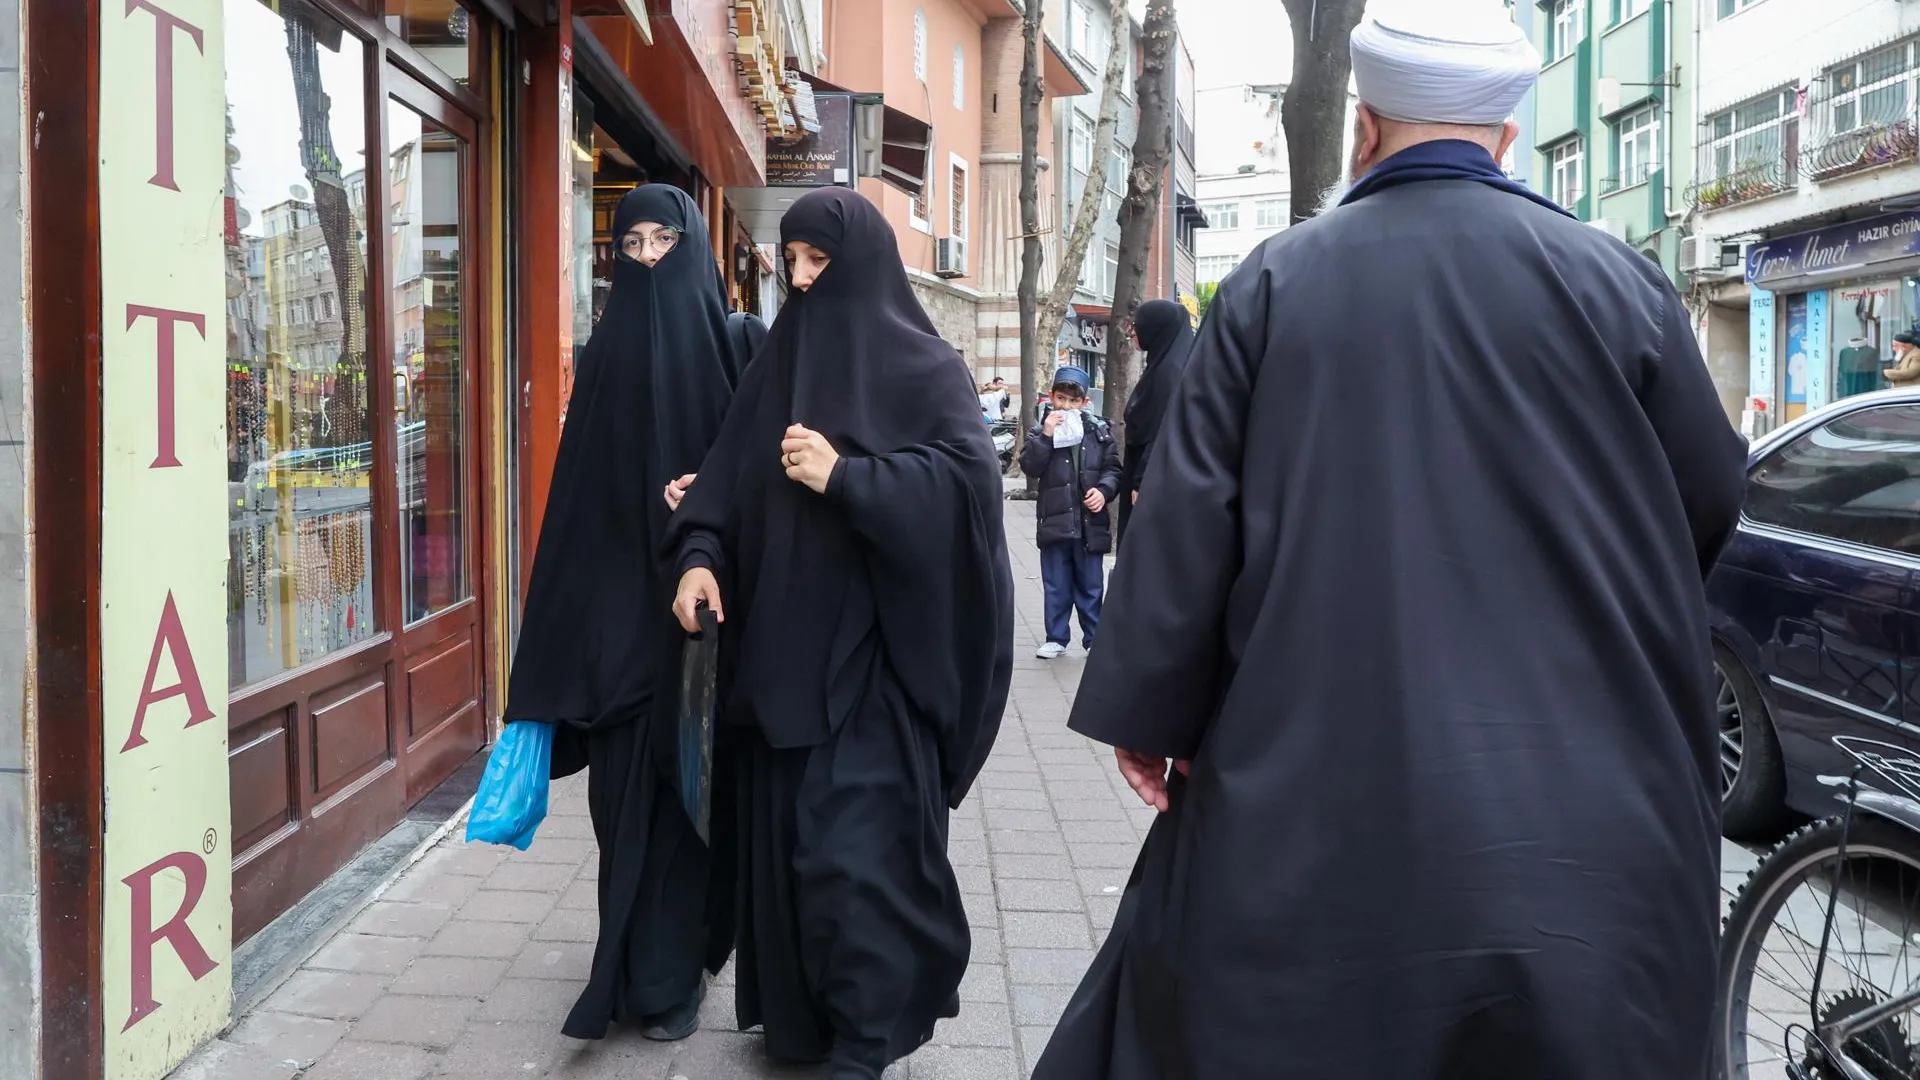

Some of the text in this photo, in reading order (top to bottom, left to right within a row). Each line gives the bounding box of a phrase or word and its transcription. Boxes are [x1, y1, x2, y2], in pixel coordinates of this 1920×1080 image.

[1858, 226, 1889, 243] HAZIR
[1748, 235, 1850, 279] Terzi Ahmet
